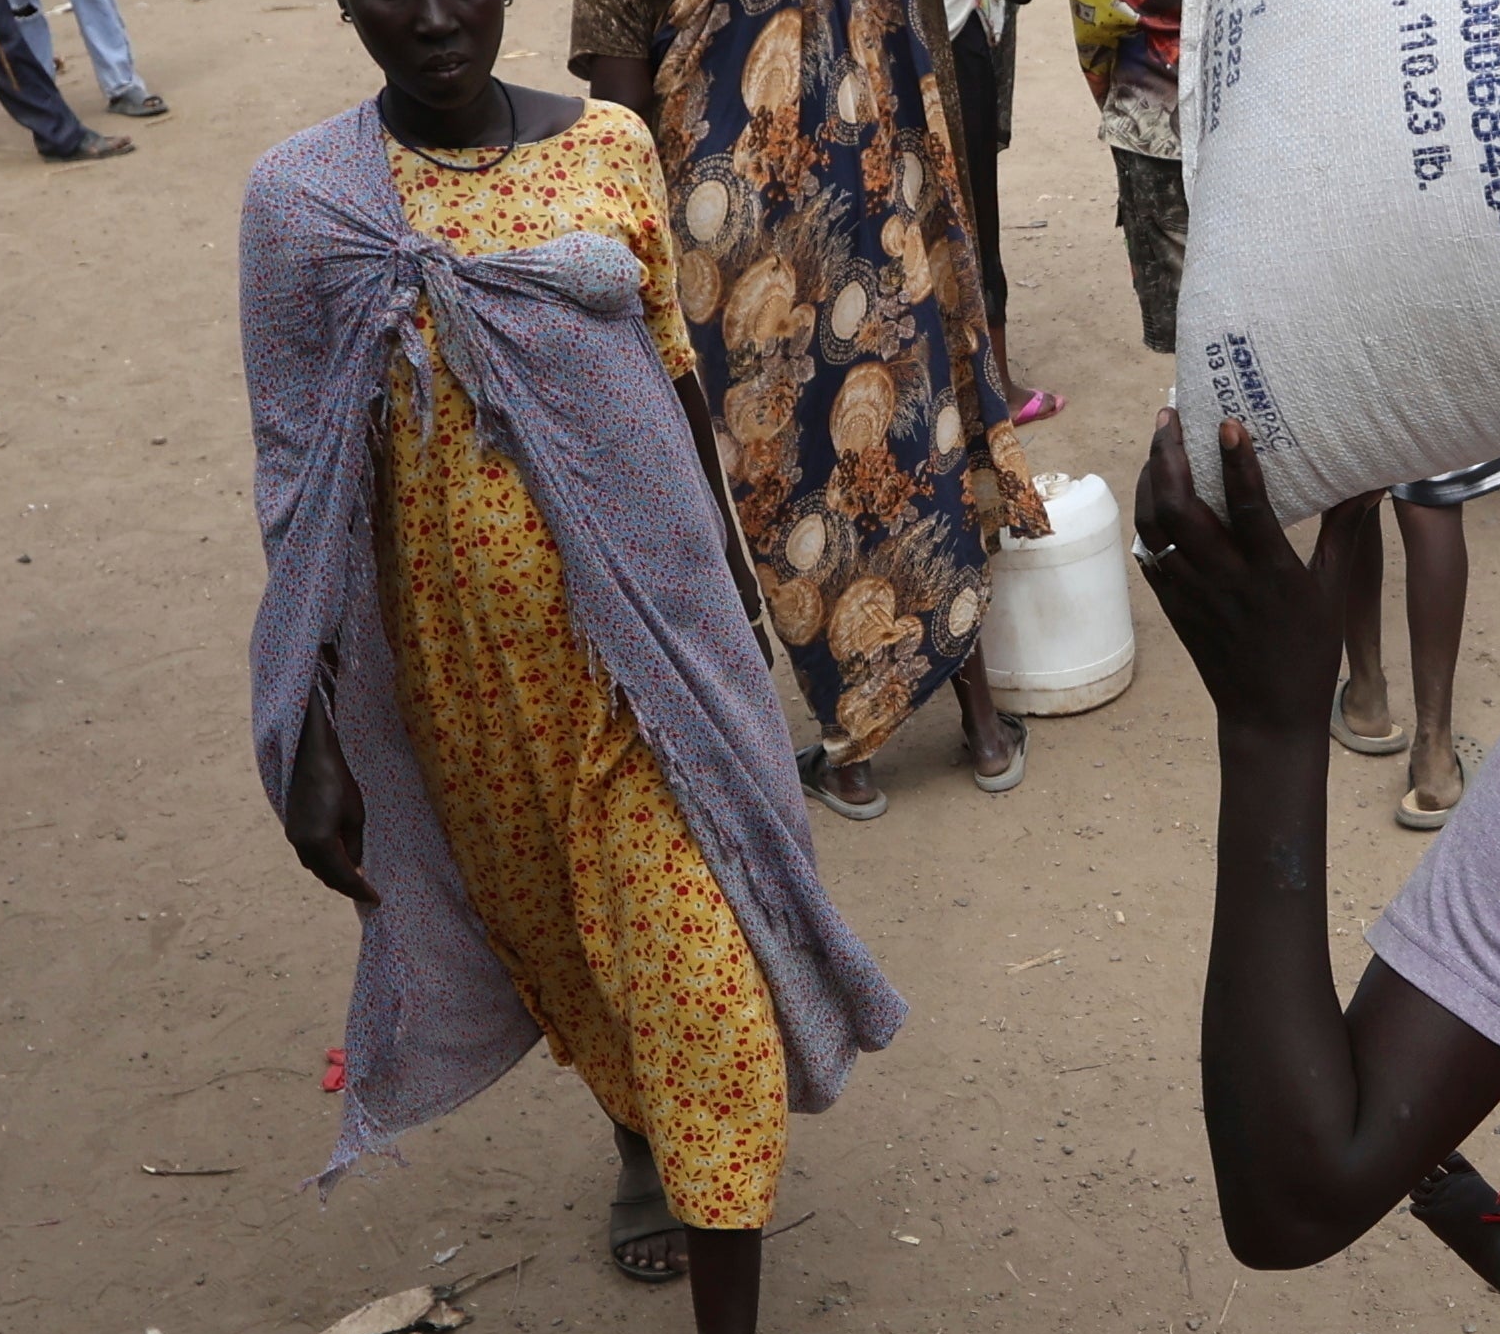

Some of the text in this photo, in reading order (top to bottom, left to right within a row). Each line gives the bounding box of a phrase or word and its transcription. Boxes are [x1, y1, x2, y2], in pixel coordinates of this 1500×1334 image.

[1251, 0, 1267, 17] 1
[1225, 11, 1243, 88] 2023
[1400, 13, 1446, 135] 110.23
[1412, 144, 1452, 192] lb.
[1205, 341, 1226, 371] 03
